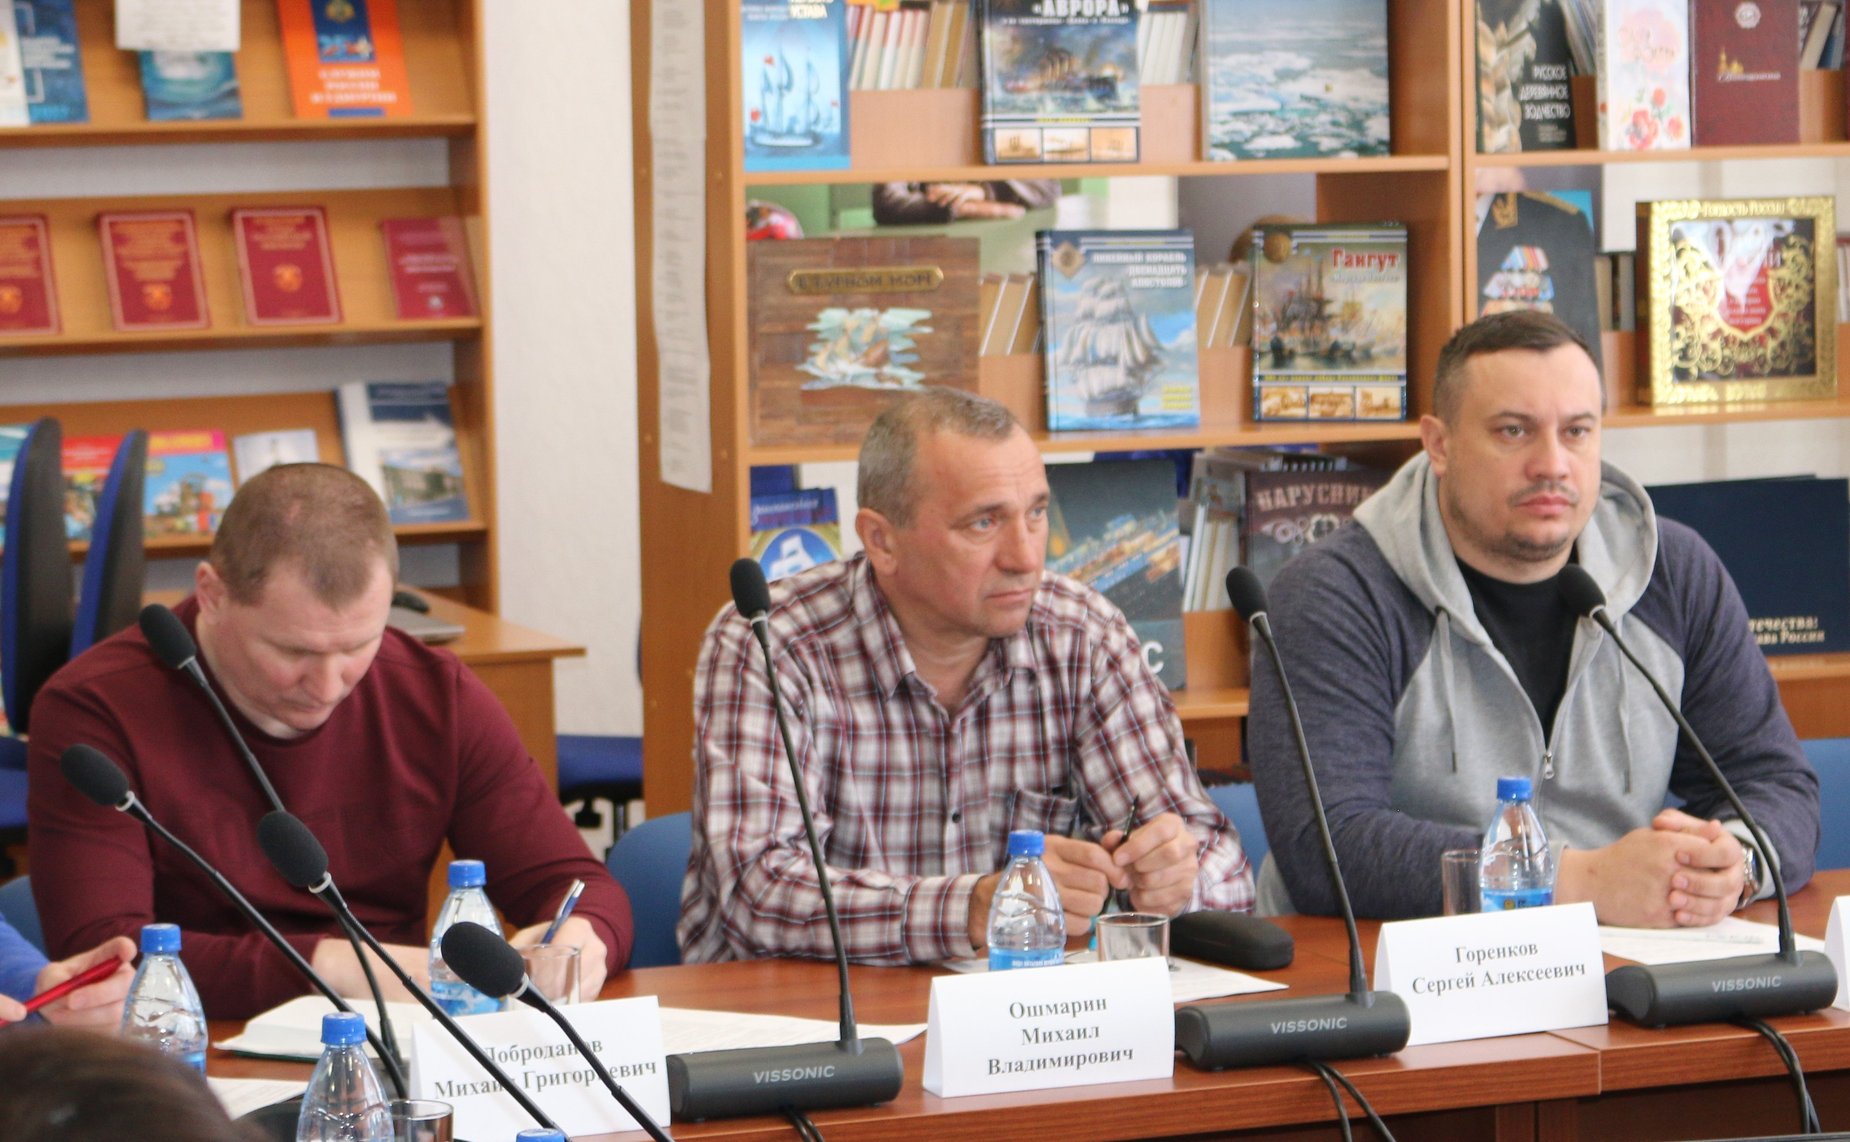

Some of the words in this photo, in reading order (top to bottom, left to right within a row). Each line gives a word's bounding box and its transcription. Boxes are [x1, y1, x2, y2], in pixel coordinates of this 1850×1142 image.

[1533, 64, 1567, 80] РУССКОЕ
[1524, 103, 1571, 120] ЗОДЧЕСТВО
[1332, 247, 1400, 273] Гангут
[1748, 615, 1818, 632] течества:
[1780, 629, 1825, 644] России
[1455, 943, 1538, 965] Горенков
[1412, 972, 1475, 996] Сергей
[1481, 963, 1585, 987] Алексеевич
[1712, 976, 1782, 993] VISSONIC
[1009, 998, 1107, 1019] Ошмарин
[1271, 1017, 1348, 1034] VISSONIC
[1022, 1026, 1100, 1045] Михаил
[988, 1049, 1133, 1075] Владимирович
[435, 1076, 517, 1100] Михаи
[523, 1061, 656, 1092] Григоревич
[753, 1065, 836, 1084] VISSONIC
